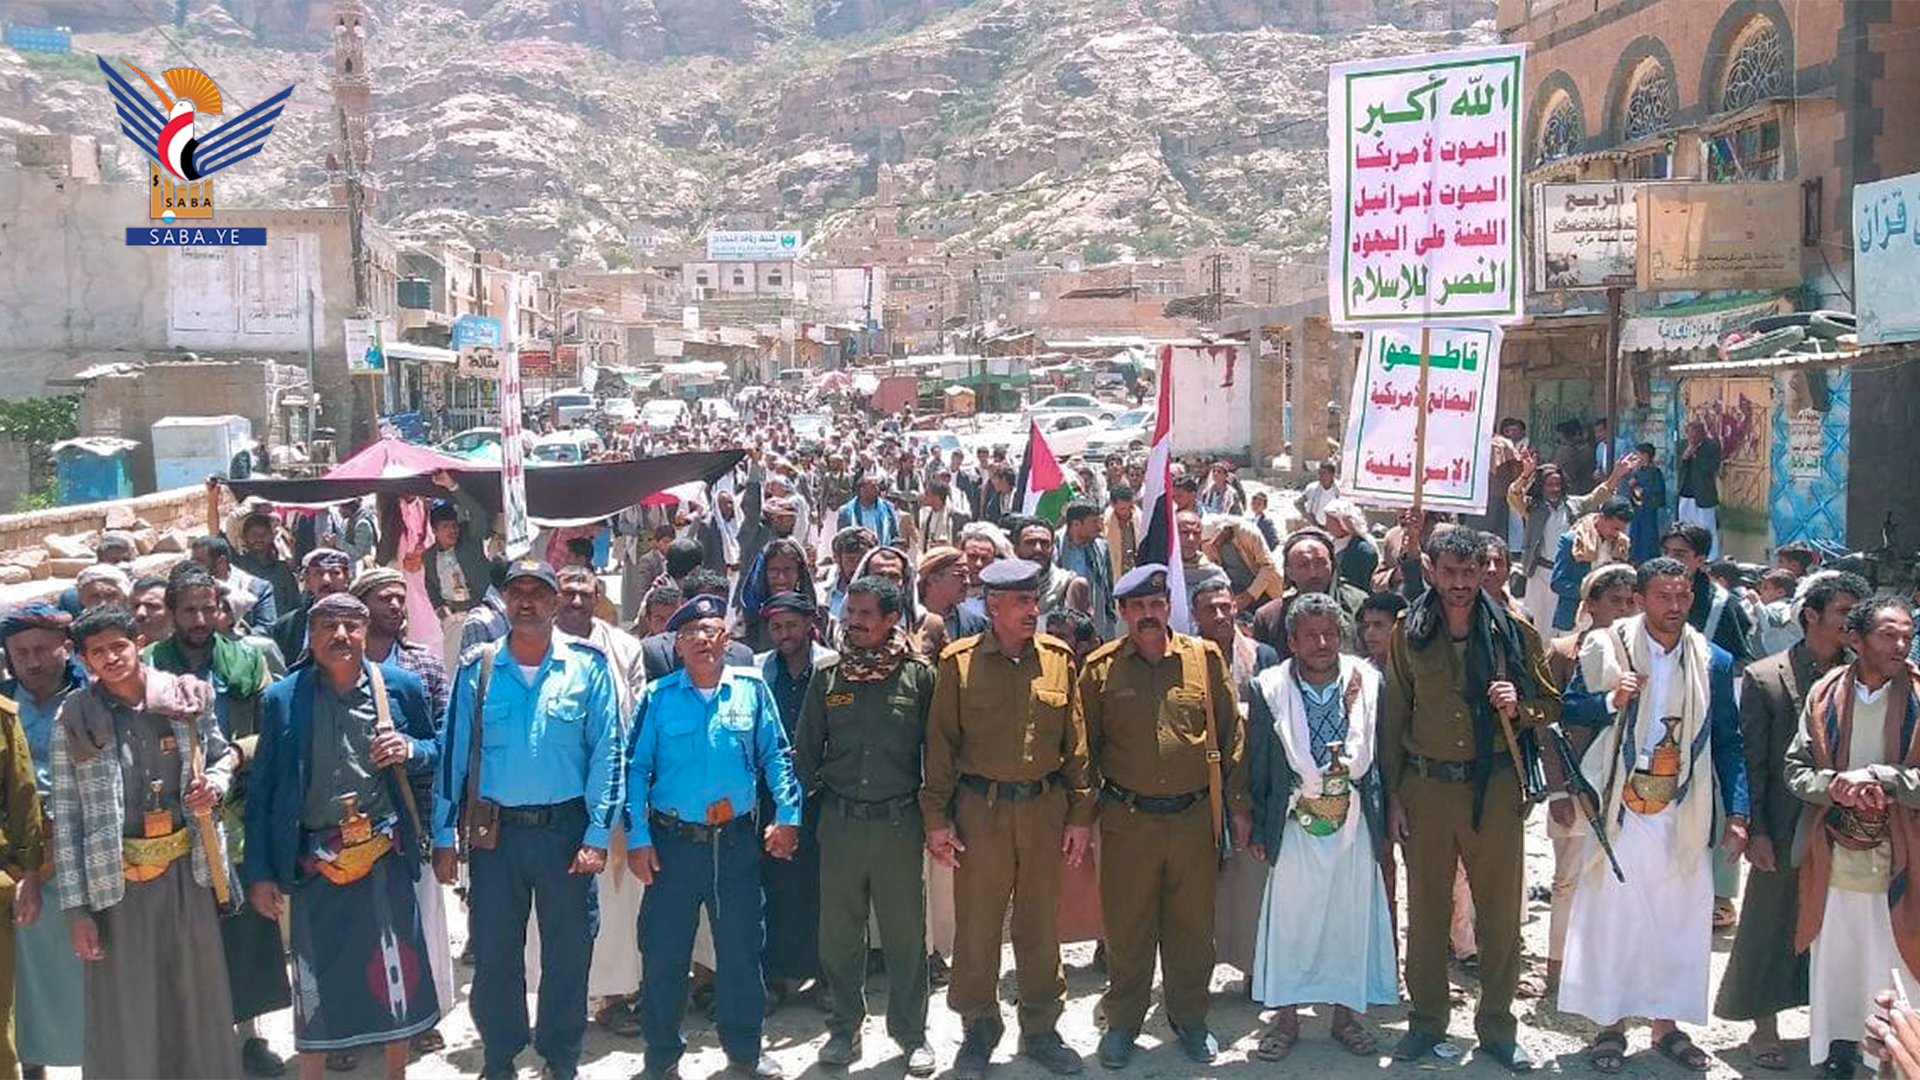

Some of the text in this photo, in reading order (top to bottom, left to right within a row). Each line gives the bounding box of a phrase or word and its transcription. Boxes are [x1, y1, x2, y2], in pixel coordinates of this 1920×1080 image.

[1355, 73, 1448, 138] أكبر
[1440, 130, 1506, 167] الموت
[1439, 175, 1506, 210] الموت
[1565, 186, 1625, 212] الربيع
[1352, 219, 1506, 258] اللعنة على اليهود
[1352, 256, 1506, 309] النصر للإسلام
[1379, 335, 1479, 372] قاطعوا
[1427, 384, 1478, 417] البضائع
